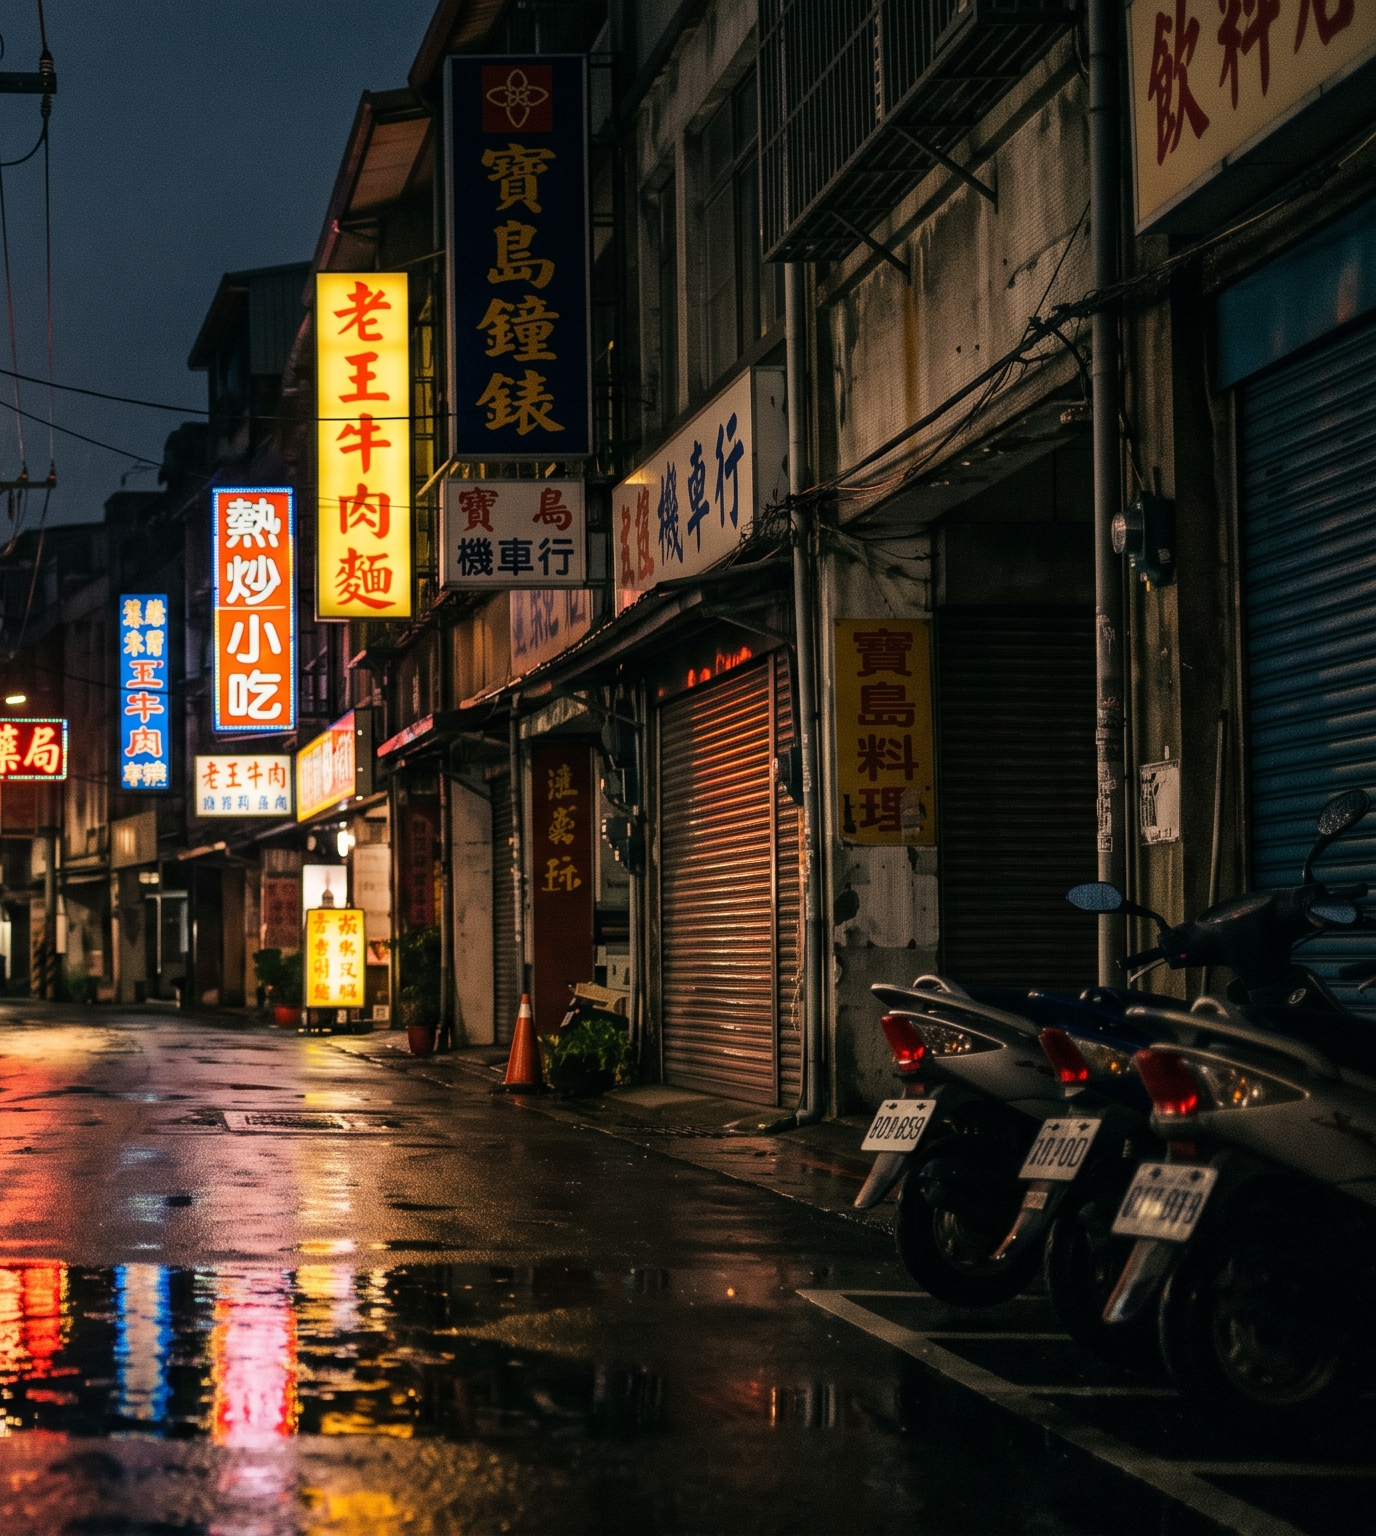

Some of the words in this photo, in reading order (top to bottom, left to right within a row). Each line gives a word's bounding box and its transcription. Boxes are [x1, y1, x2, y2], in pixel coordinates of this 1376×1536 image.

[475, 142, 566, 436] 寶島鐘錶
[333, 281, 397, 609] 老王牛肉麵
[657, 412, 745, 566] 機車行
[225, 497, 282, 720] 熱炒小吃
[457, 537, 574, 576] 機車行
[202, 761, 286, 790] 老王牛肉
[853, 628, 922, 832] 寶島料理
